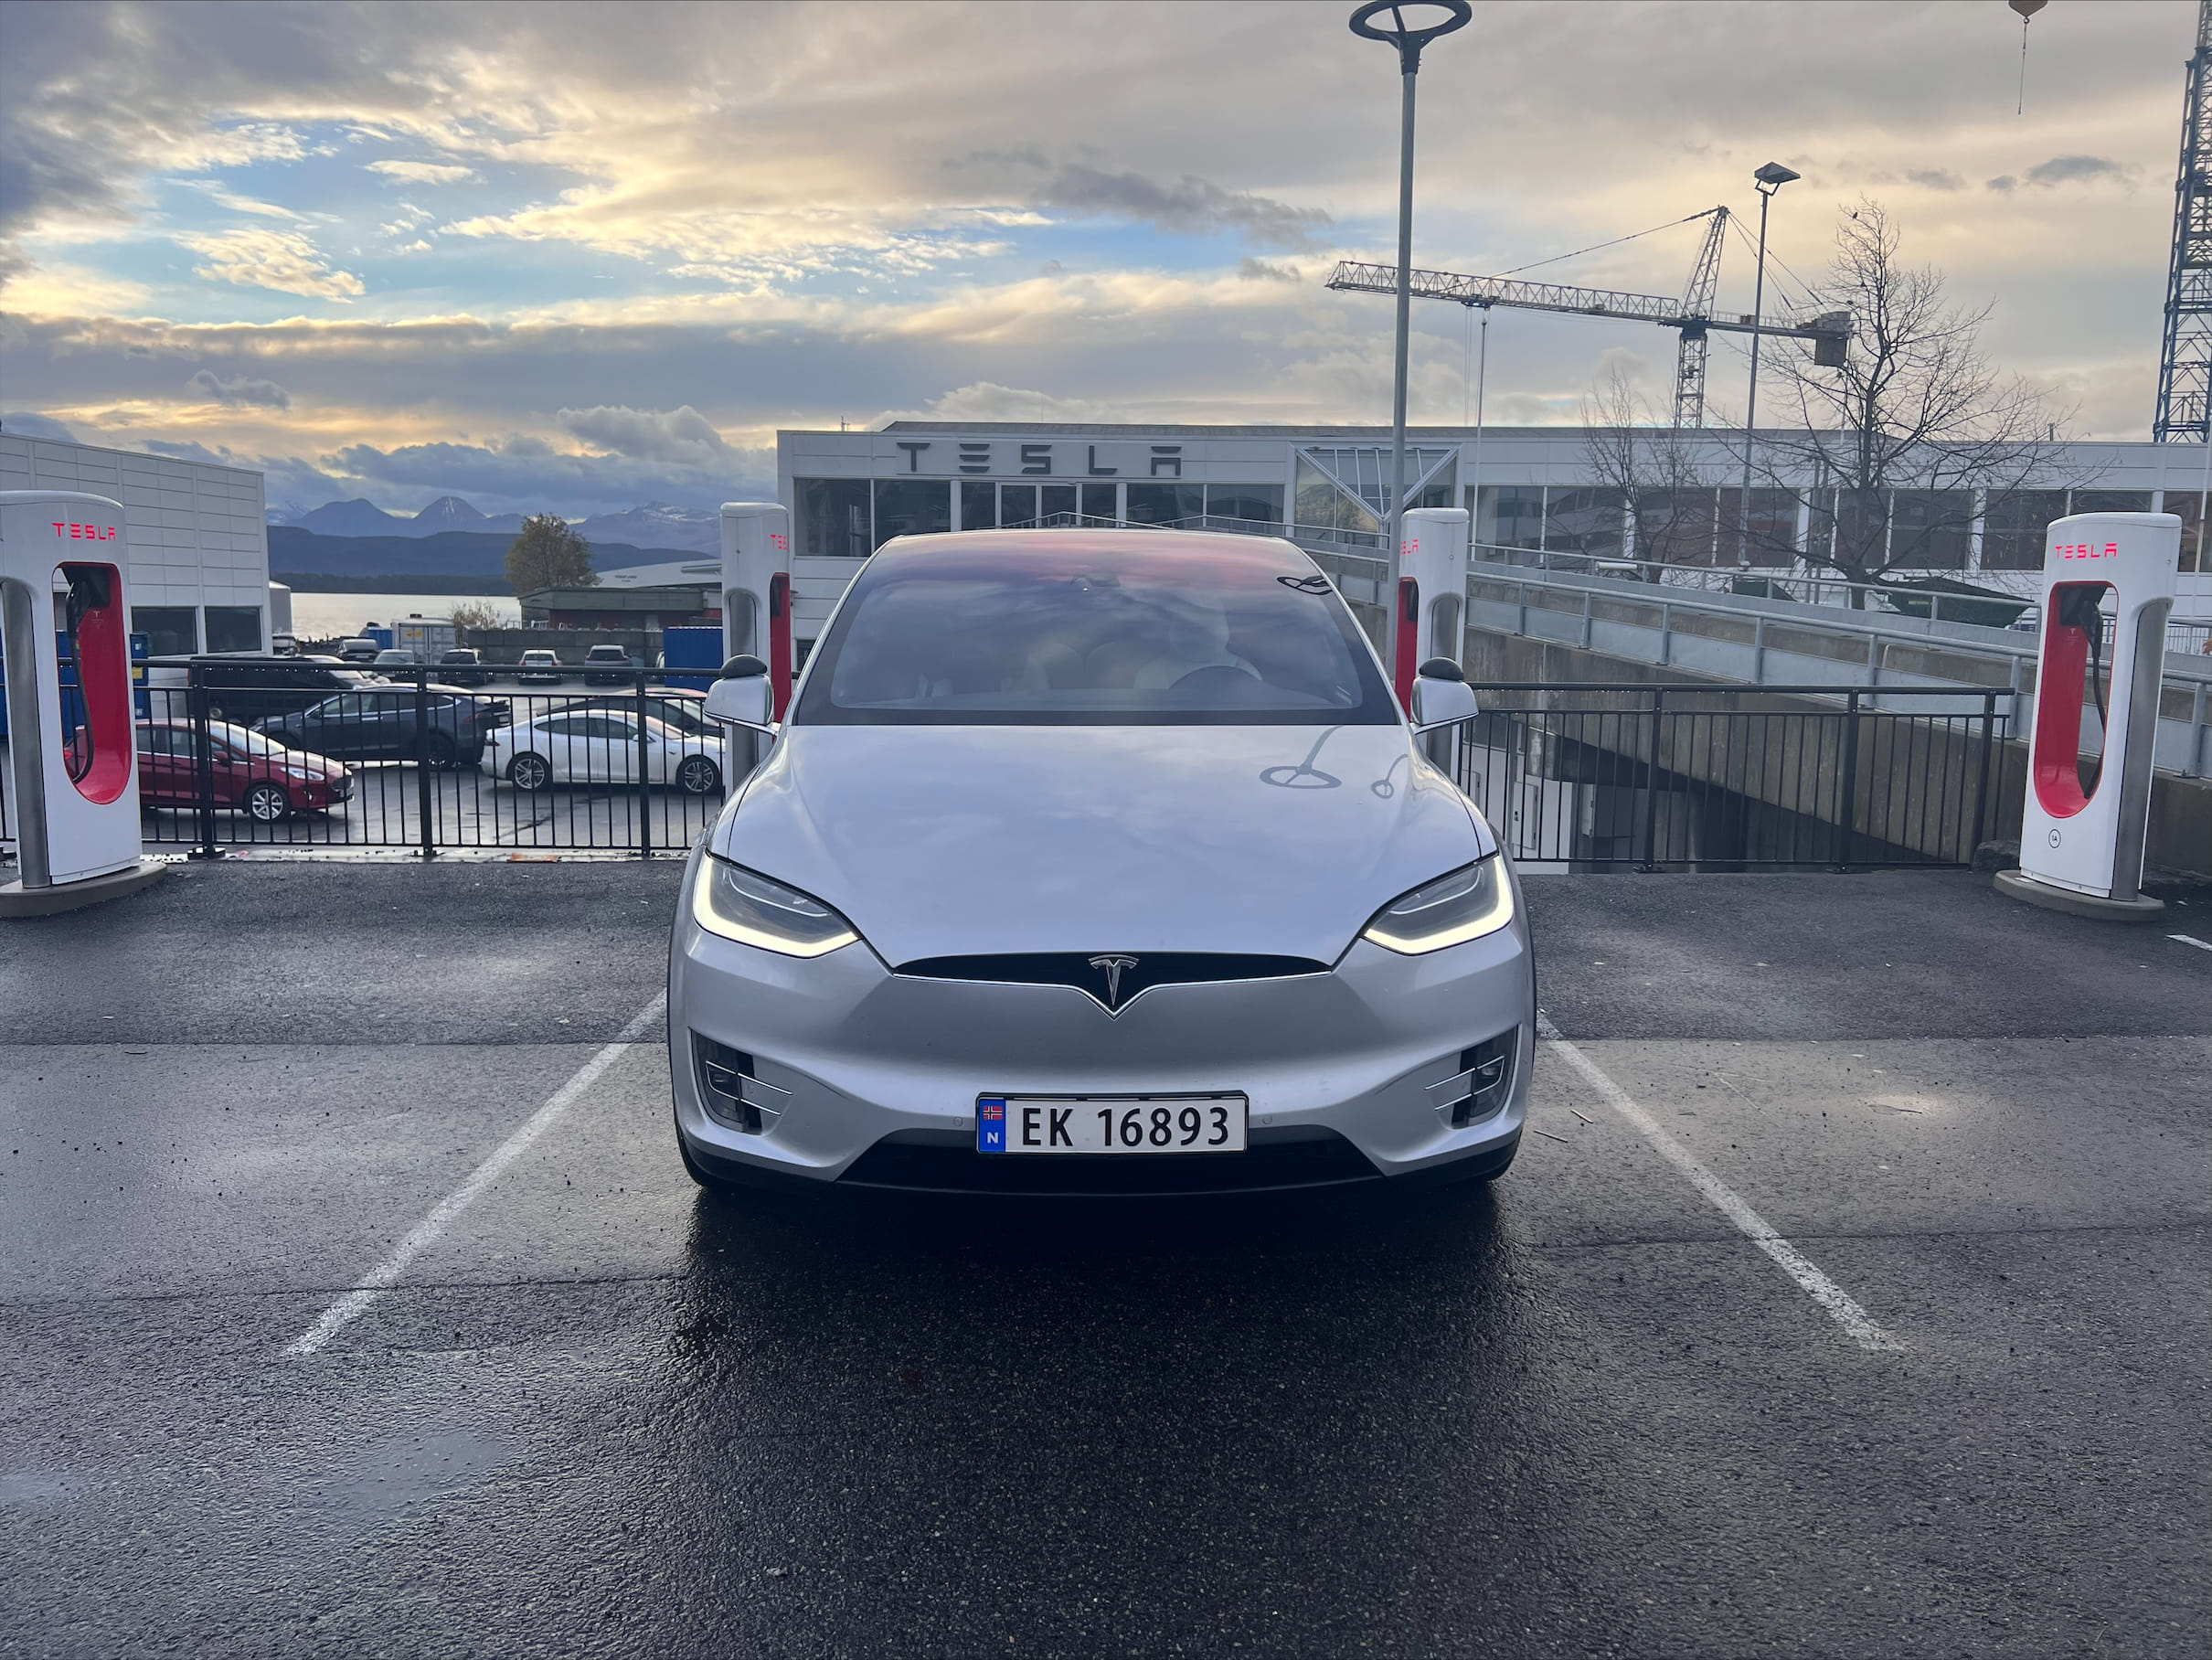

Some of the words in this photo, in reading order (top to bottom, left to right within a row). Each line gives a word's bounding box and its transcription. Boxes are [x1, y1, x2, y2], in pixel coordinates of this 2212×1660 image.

[896, 442, 1182, 476] TESLA
[51, 522, 117, 541] TESLA
[2055, 543, 2118, 559] TESLA
[1022, 1107, 1074, 1147] EK
[1097, 1107, 1229, 1147] 16893
[986, 1132, 999, 1144] N
